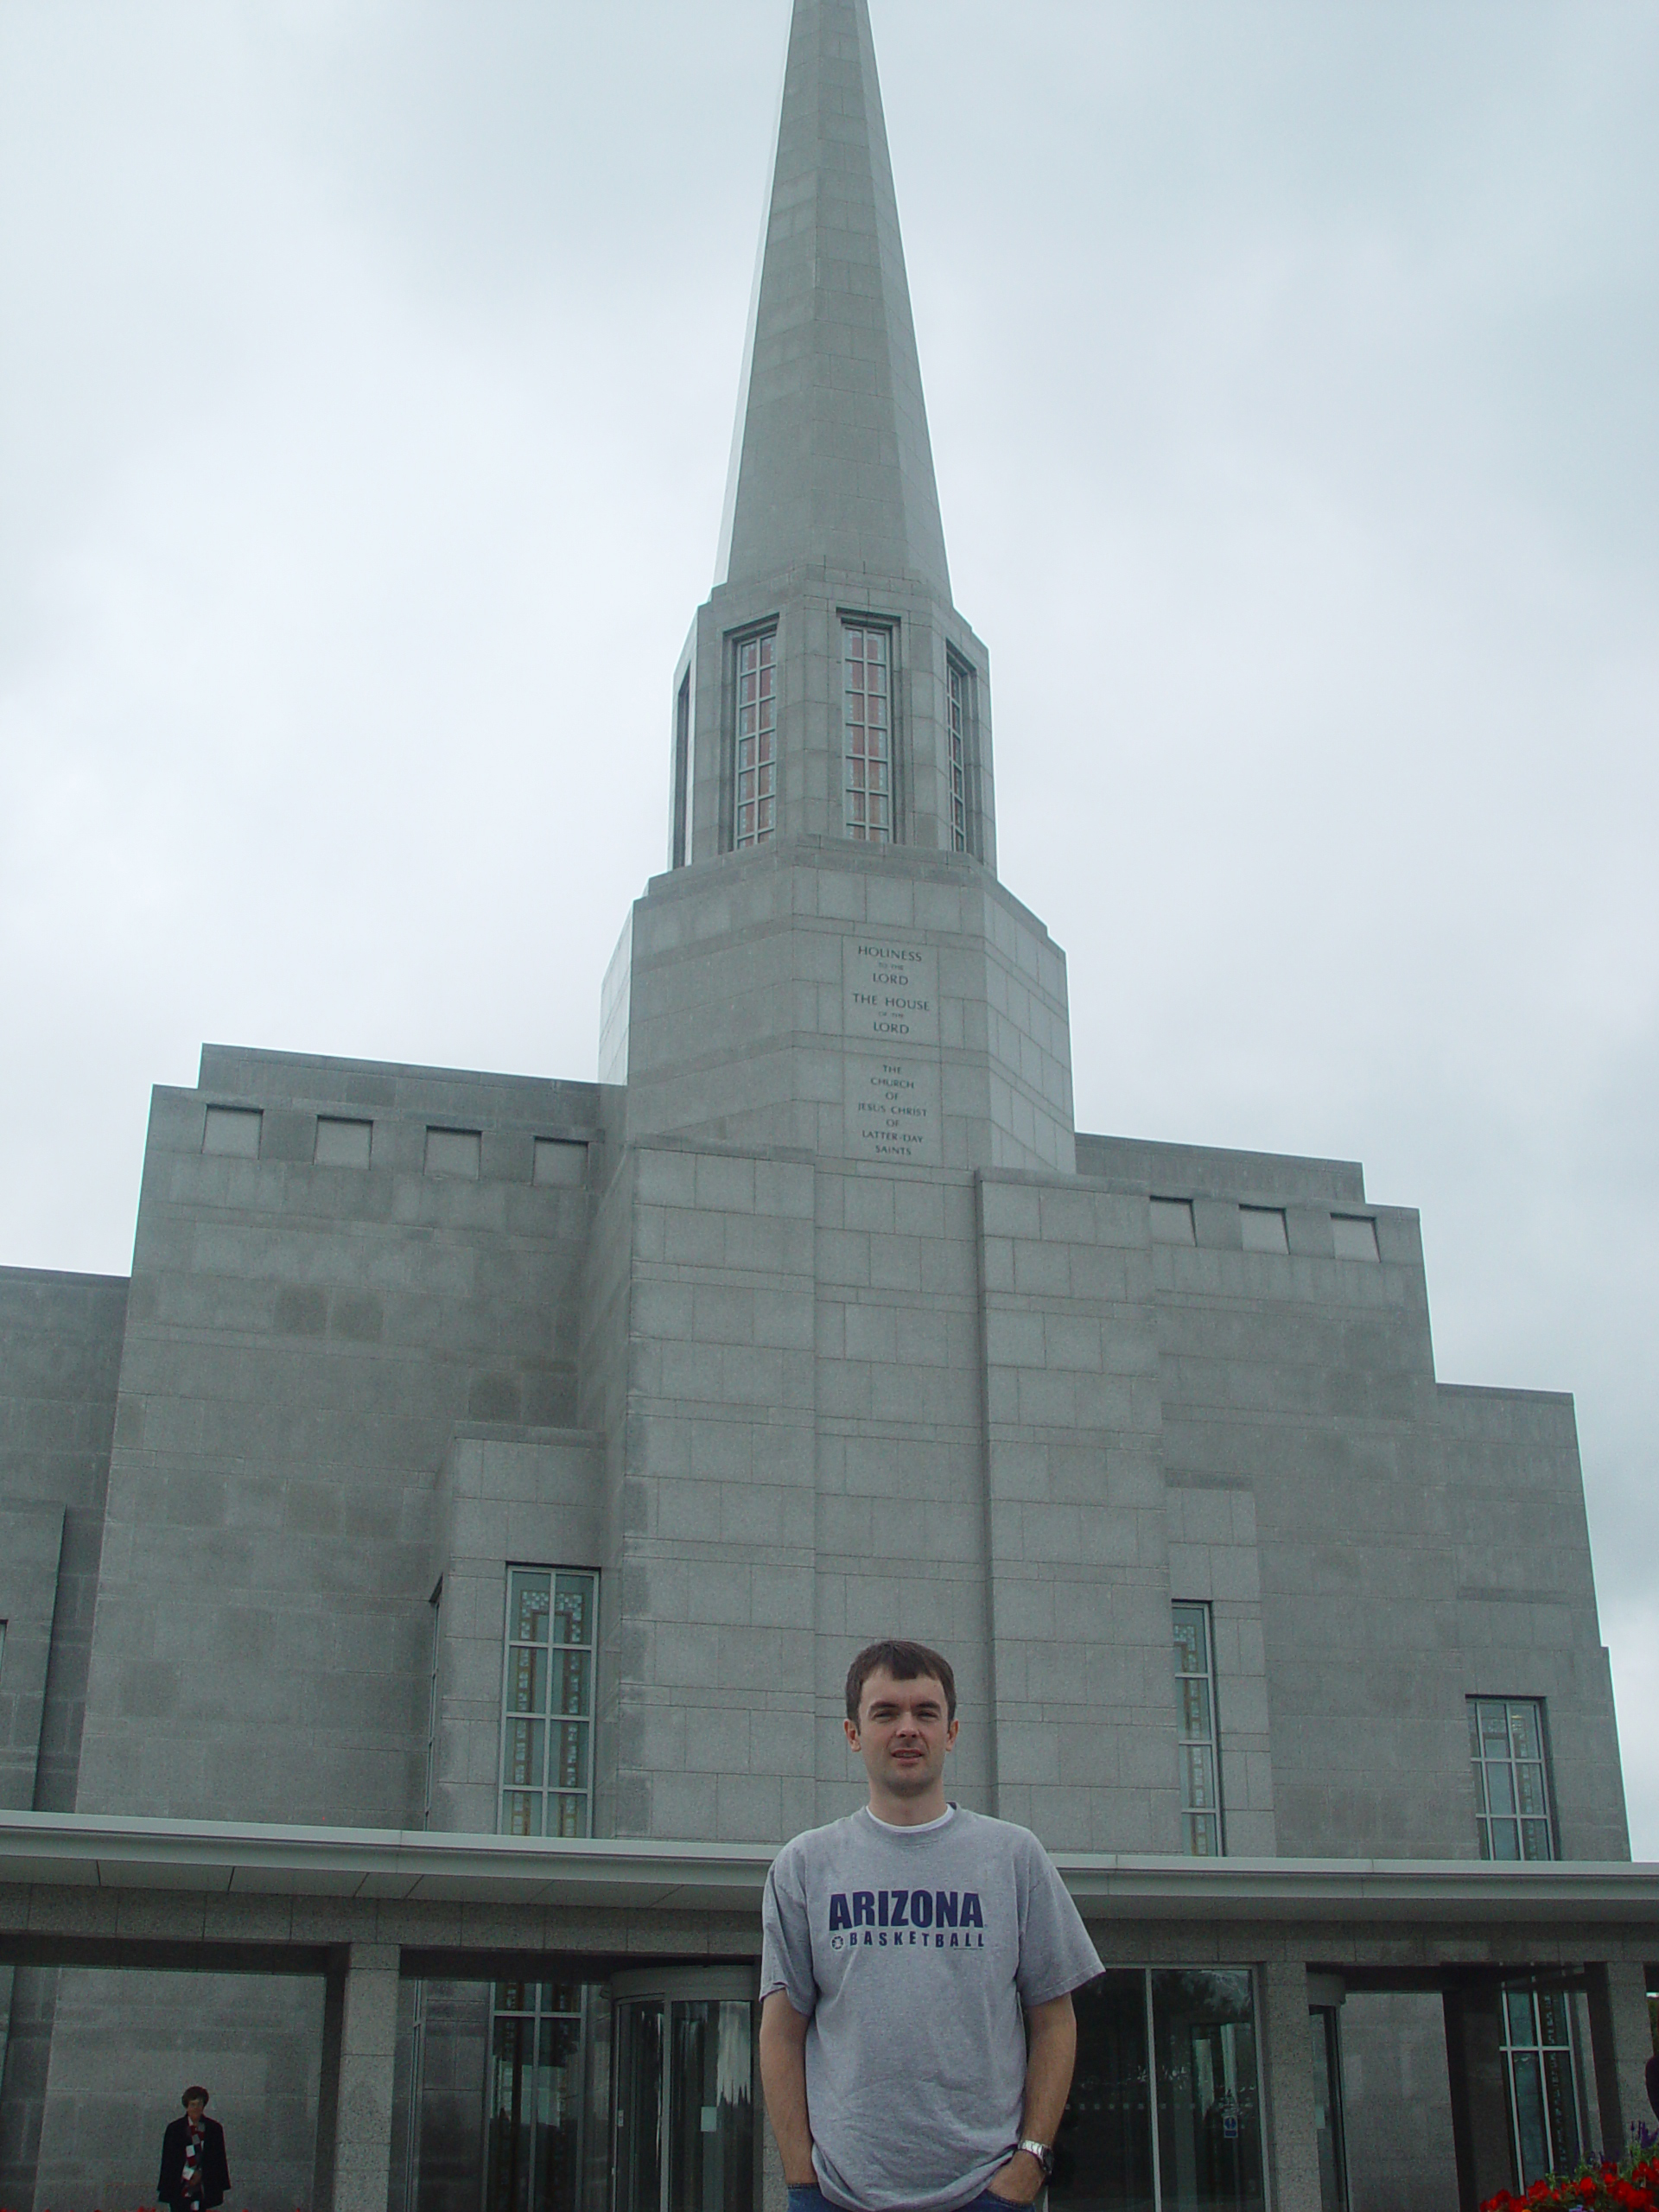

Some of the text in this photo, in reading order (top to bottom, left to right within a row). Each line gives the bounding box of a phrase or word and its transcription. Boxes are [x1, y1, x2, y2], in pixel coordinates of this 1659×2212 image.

[858, 945, 922, 962] HOLINESS
[873, 973, 909, 986] LORD
[853, 993, 930, 1011] THE HOUSE
[874, 1021, 910, 1034] LORD
[883, 1064, 901, 1074] THE
[870, 1077, 915, 1089] CHURCH
[885, 1091, 899, 1100] OF
[858, 1103, 927, 1116] JESUS CHRIST
[886, 1118, 899, 1127] OF
[875, 1145, 912, 1155] SAINTS
[829, 1890, 983, 1931] ARIZONA
[849, 1931, 984, 1948] BASKETBALL
